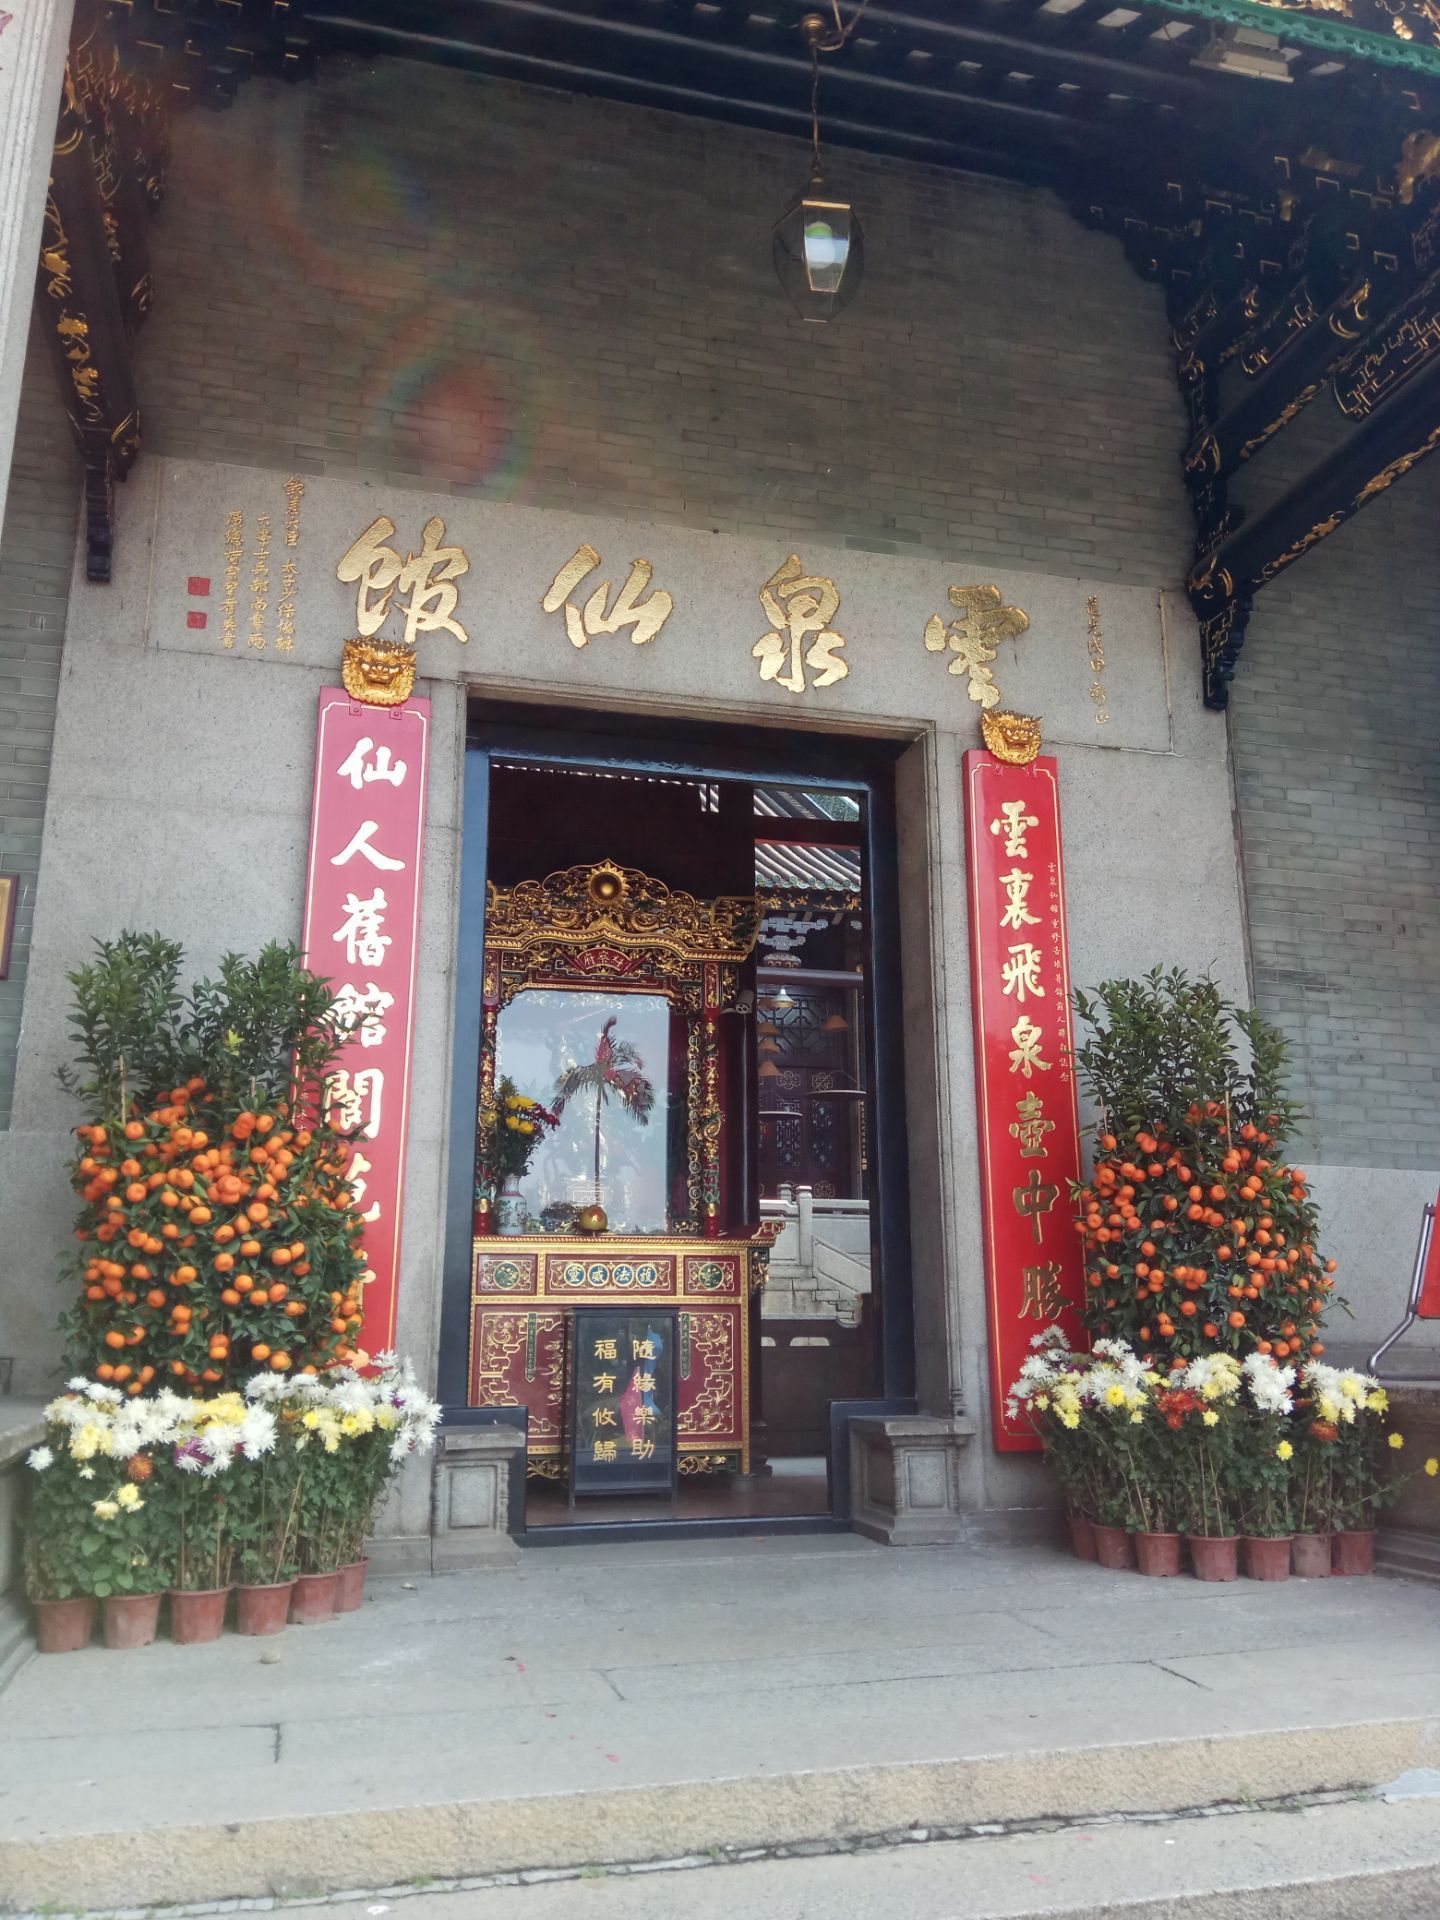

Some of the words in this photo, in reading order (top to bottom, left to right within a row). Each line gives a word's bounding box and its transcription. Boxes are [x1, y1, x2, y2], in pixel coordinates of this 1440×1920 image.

[592, 1338, 617, 1463] 福有攸歸
[631, 1340, 657, 1460] 隨緣樂助
